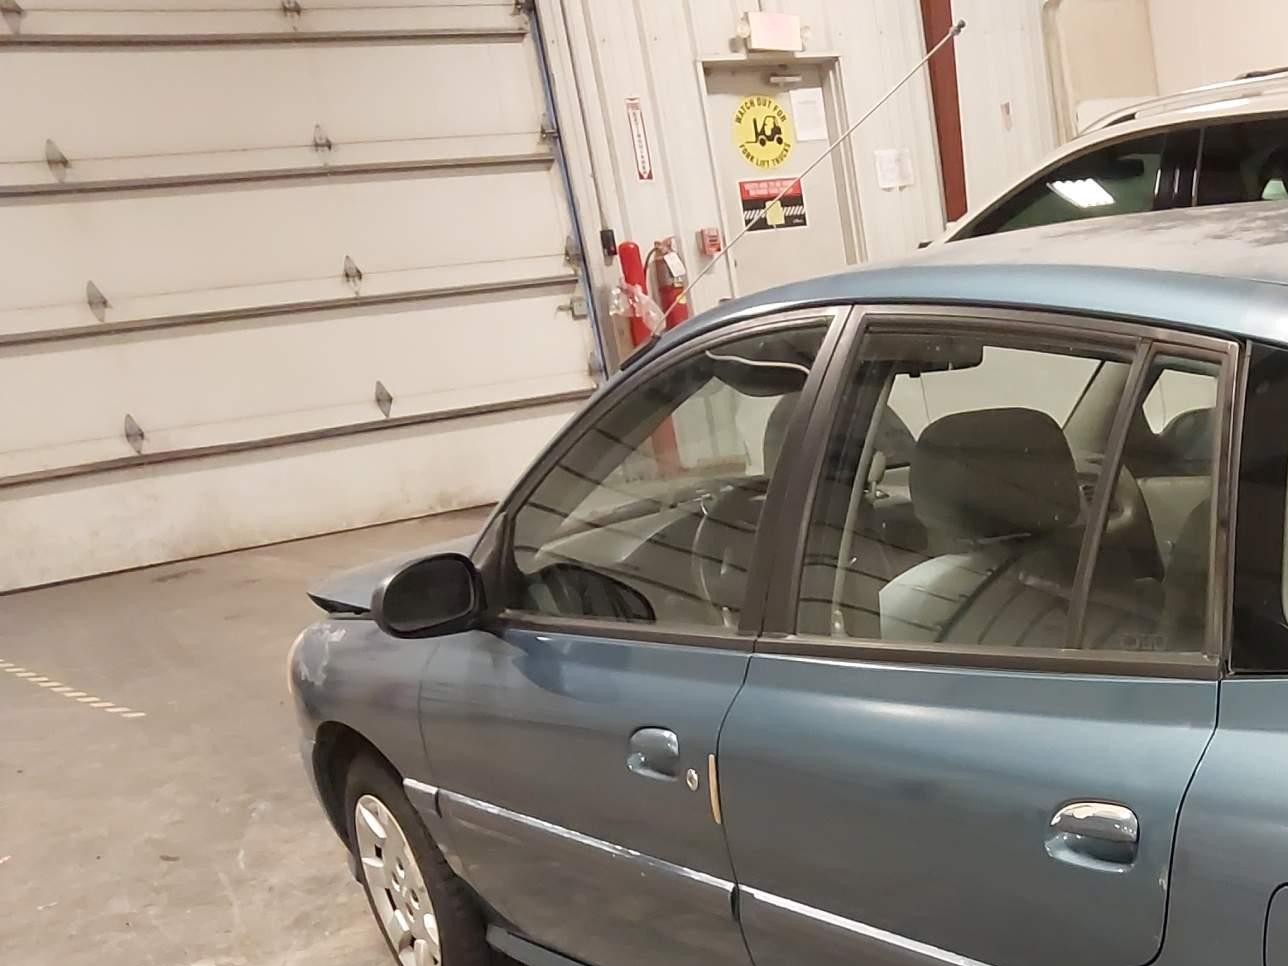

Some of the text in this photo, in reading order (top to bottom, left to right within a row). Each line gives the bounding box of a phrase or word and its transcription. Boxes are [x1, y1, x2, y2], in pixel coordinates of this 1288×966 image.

[735, 97, 787, 124] WATCH OUT FOR
[739, 143, 791, 168] FORK LIFT TRUCKS
